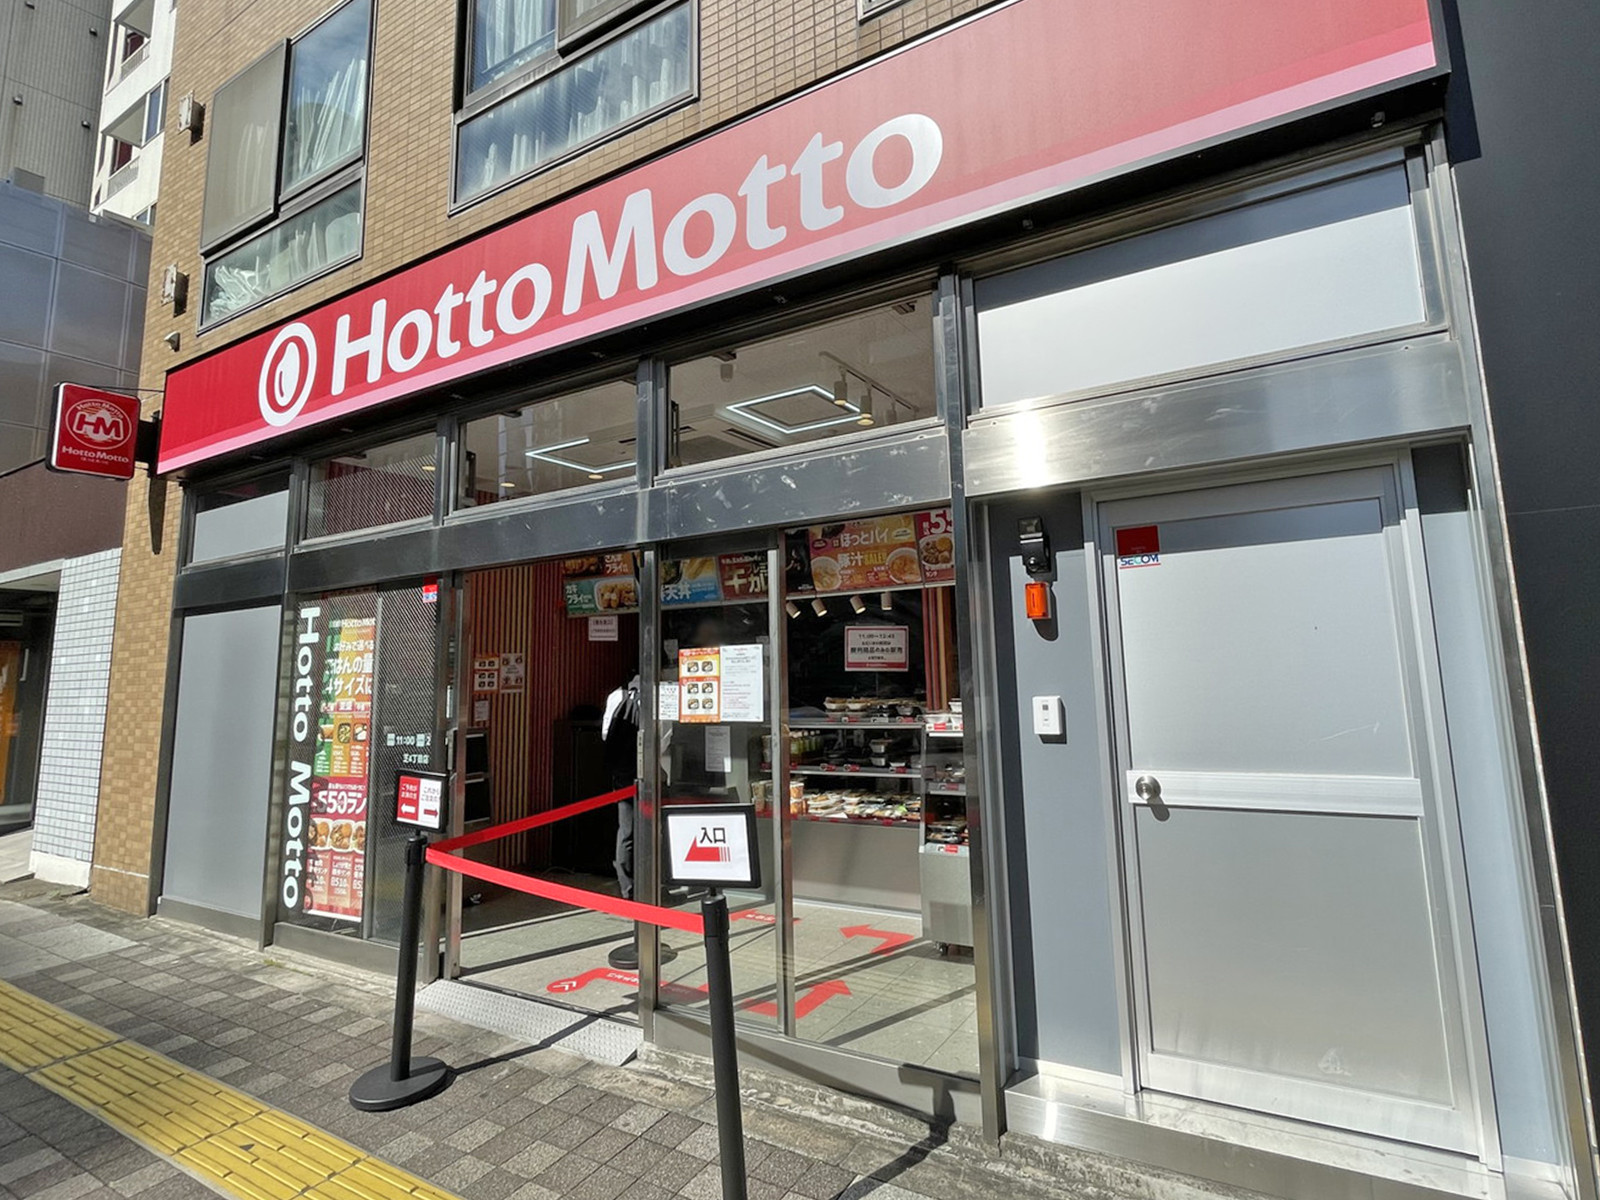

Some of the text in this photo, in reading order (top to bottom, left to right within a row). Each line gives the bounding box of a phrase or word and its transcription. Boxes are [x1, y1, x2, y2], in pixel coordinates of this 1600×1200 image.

[331, 113, 943, 396] Hotto Motto
[62, 445, 96, 459] Hotto
[96, 451, 129, 464] Motto
[283, 606, 321, 908] Hotto Motto
[699, 827, 726, 844] 入口
